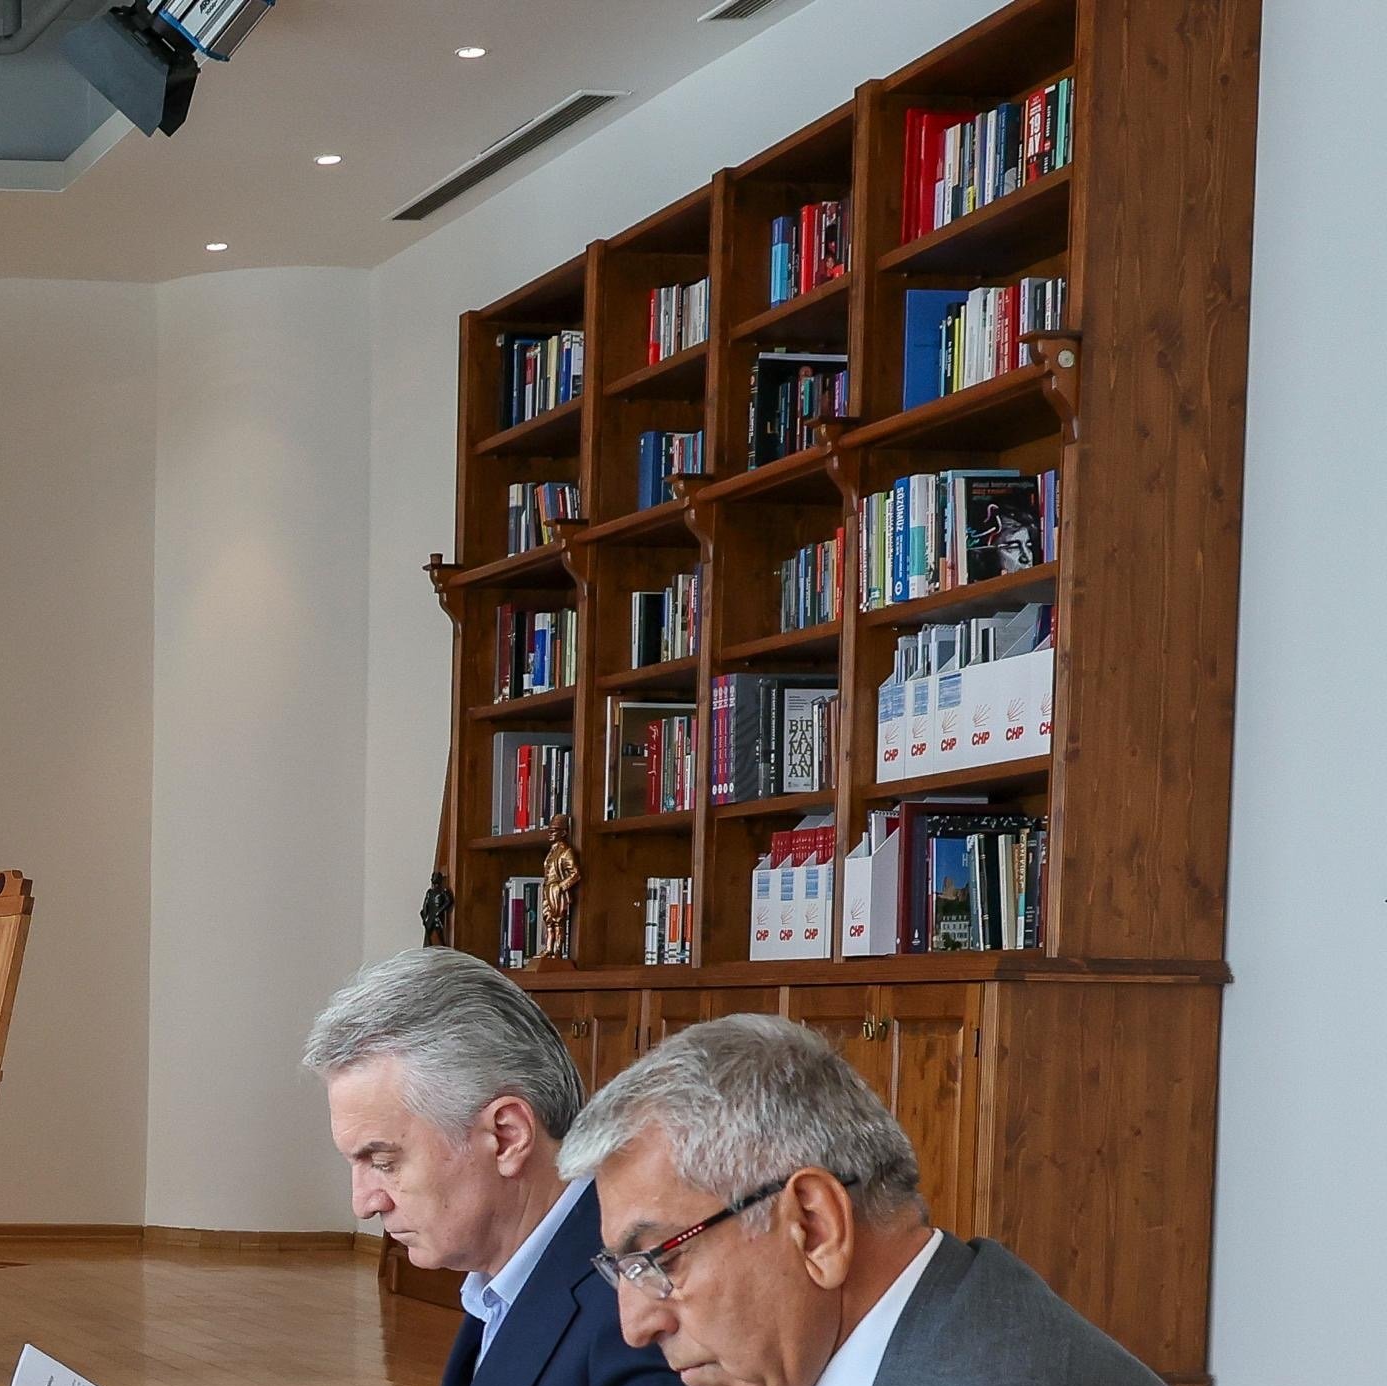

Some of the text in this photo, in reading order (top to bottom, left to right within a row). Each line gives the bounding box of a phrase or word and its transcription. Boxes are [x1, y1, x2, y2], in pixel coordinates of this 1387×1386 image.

[971, 731, 990, 745] CHP
[1006, 726, 1024, 740] CHP
[911, 743, 927, 756] CHP
[941, 738, 957, 751] CHP
[884, 749, 899, 761] CHP
[756, 929, 769, 941] CHP
[780, 929, 793, 941] CHP
[804, 928, 819, 941] CHP
[849, 924, 865, 938] CHP
